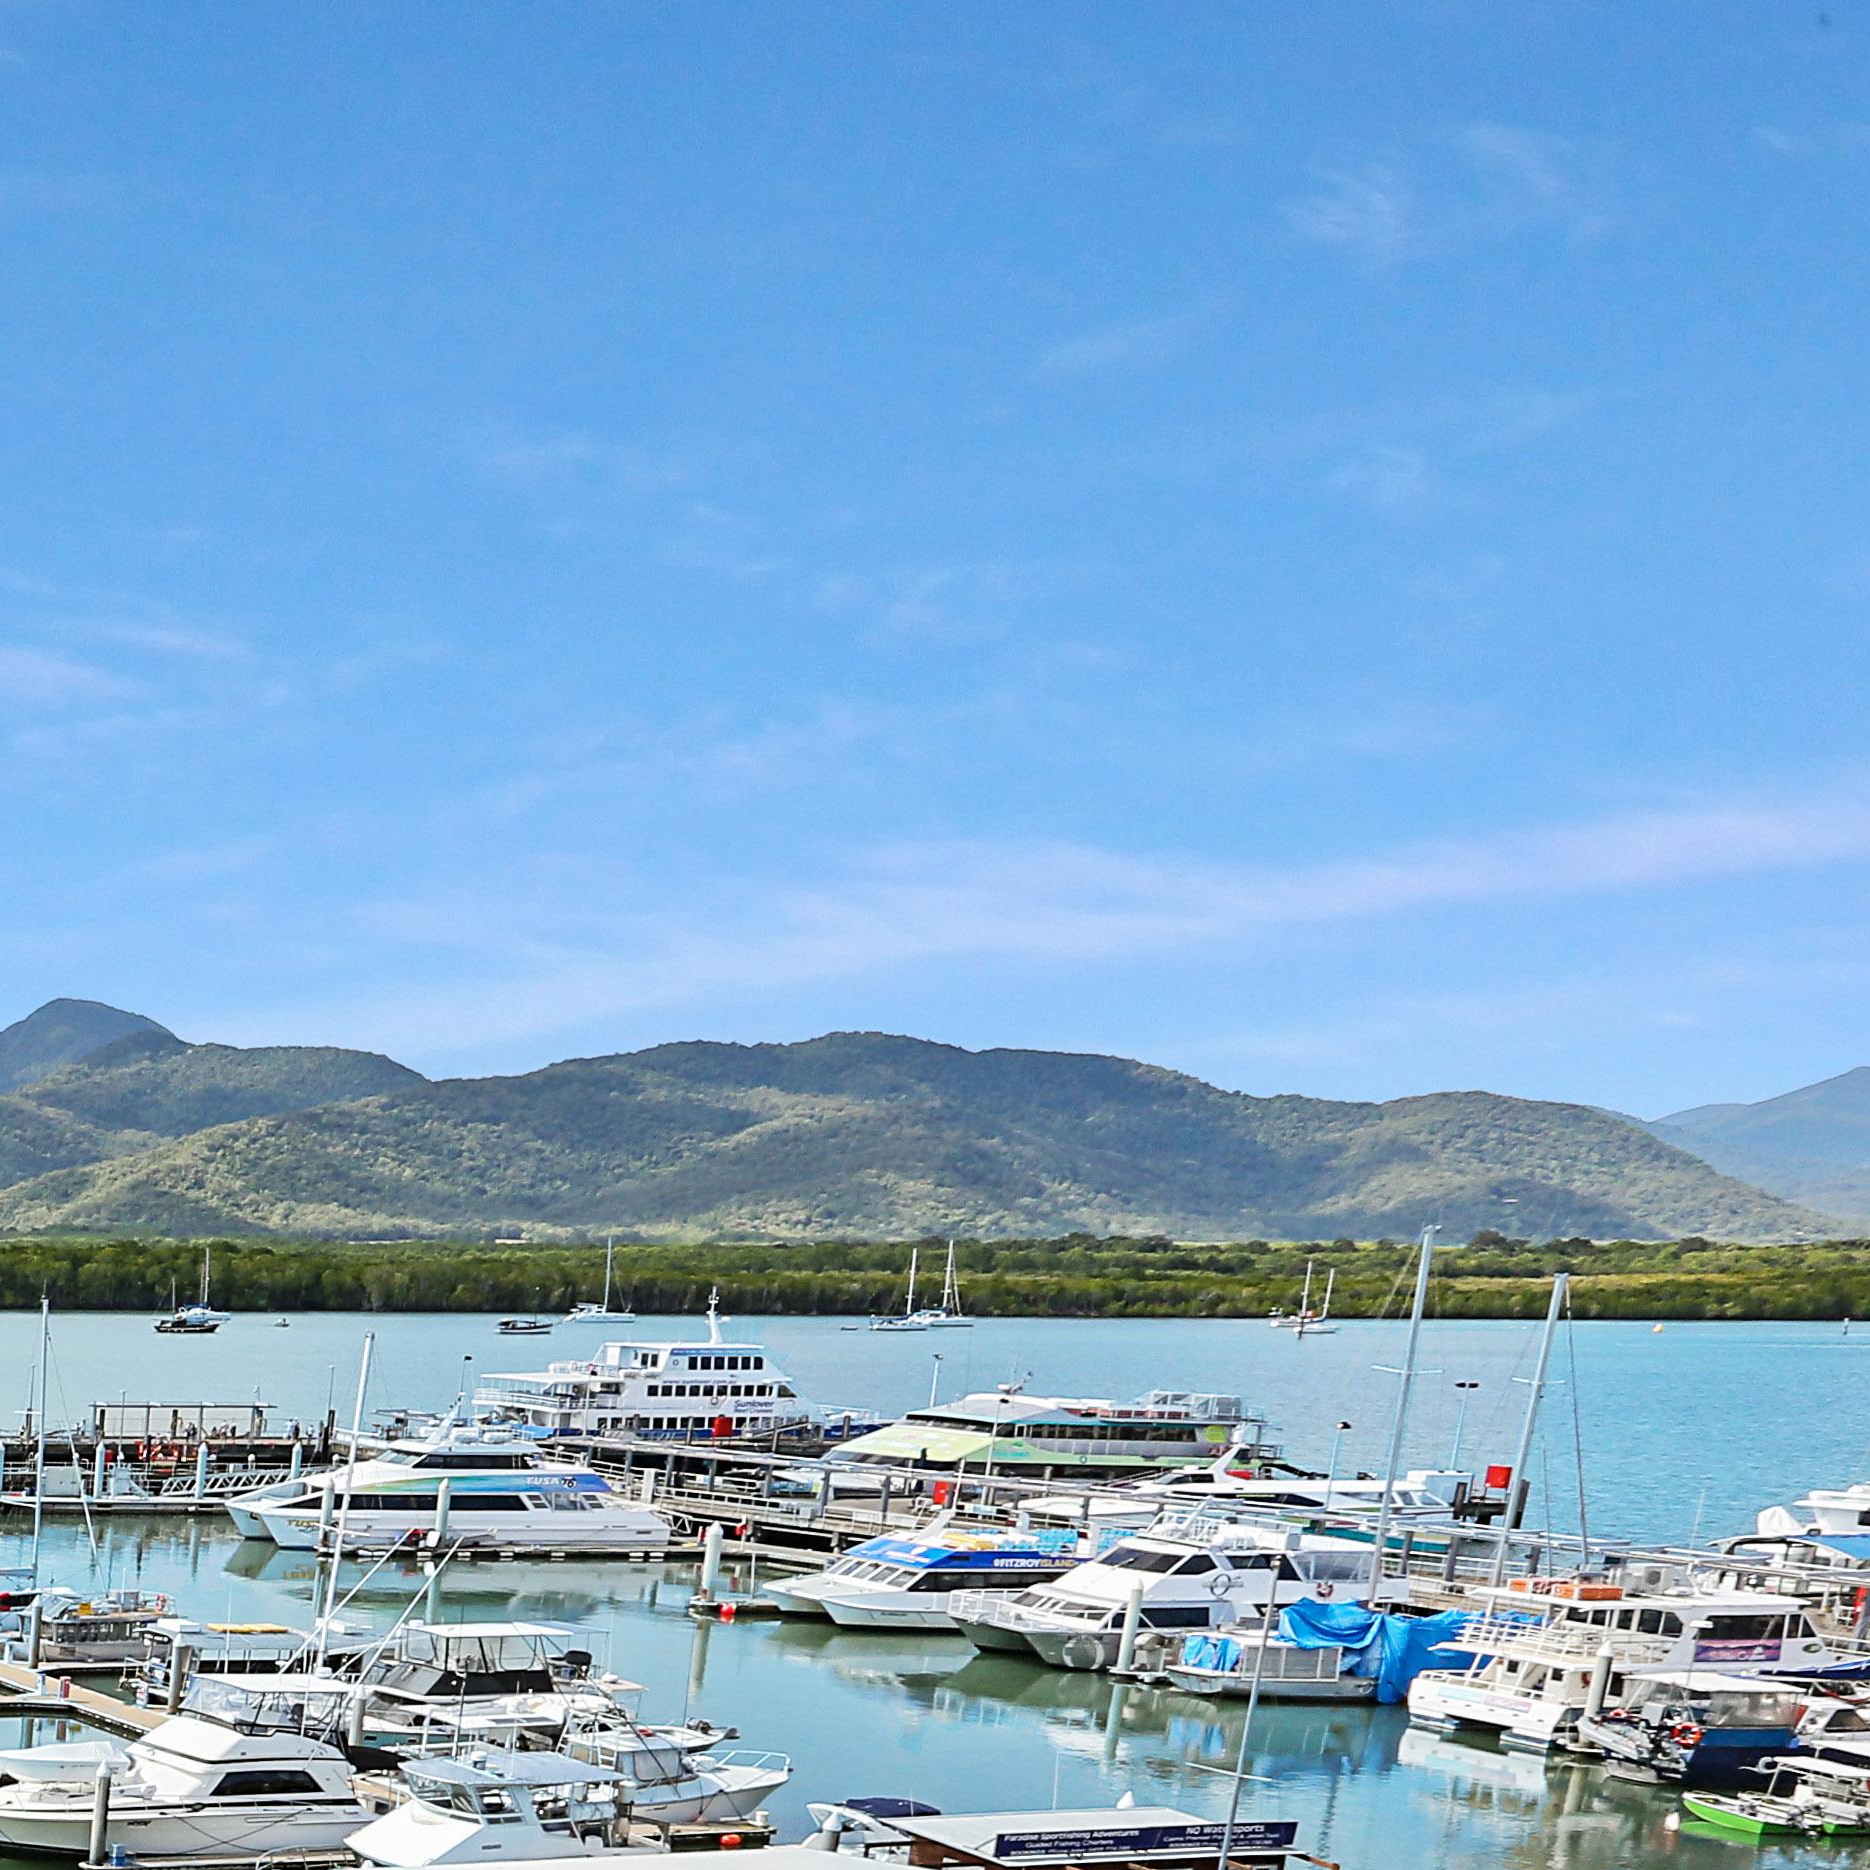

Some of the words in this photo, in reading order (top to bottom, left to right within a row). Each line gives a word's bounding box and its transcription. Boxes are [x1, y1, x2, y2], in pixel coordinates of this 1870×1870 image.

[525, 1476, 560, 1486] TUSA
[1004, 1833, 1040, 1842] Paradise
[1040, 1831, 1091, 1842] Sportfishing
[1091, 1829, 1140, 1838] Adventures
[1053, 1840, 1081, 1848] Fishing
